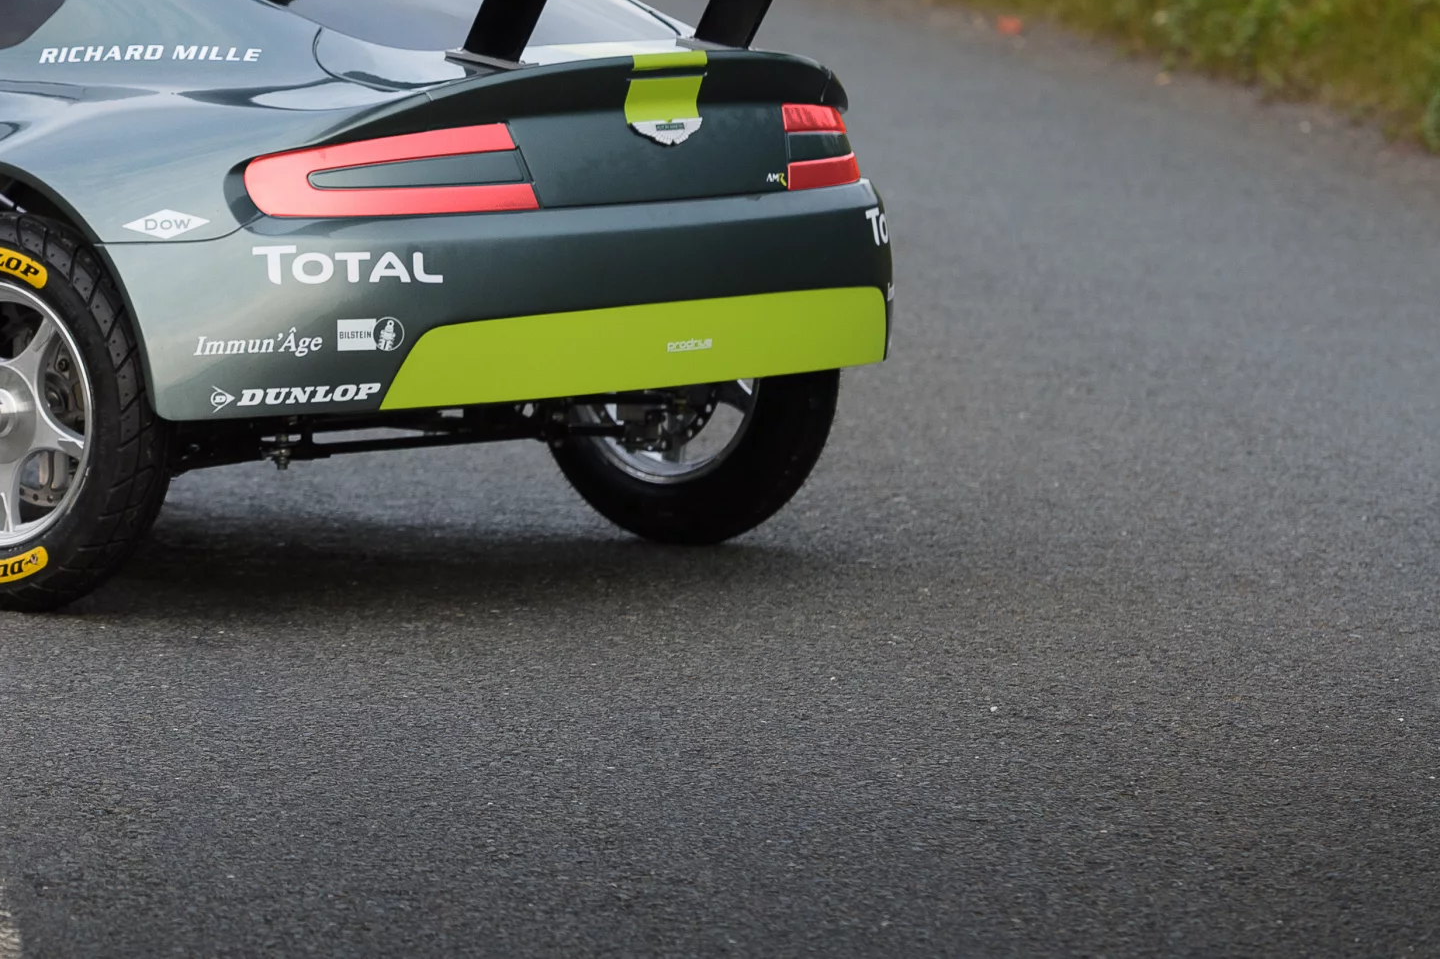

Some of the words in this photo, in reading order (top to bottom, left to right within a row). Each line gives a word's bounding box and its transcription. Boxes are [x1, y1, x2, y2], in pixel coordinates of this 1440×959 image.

[39, 44, 164, 64] RICHARD
[172, 45, 262, 62] MILLE
[144, 218, 192, 232] DOW
[865, 207, 889, 247] TO
[252, 245, 444, 285] TOTAL
[338, 330, 373, 340] BILSTEIN
[236, 382, 382, 407] DUNLOP
